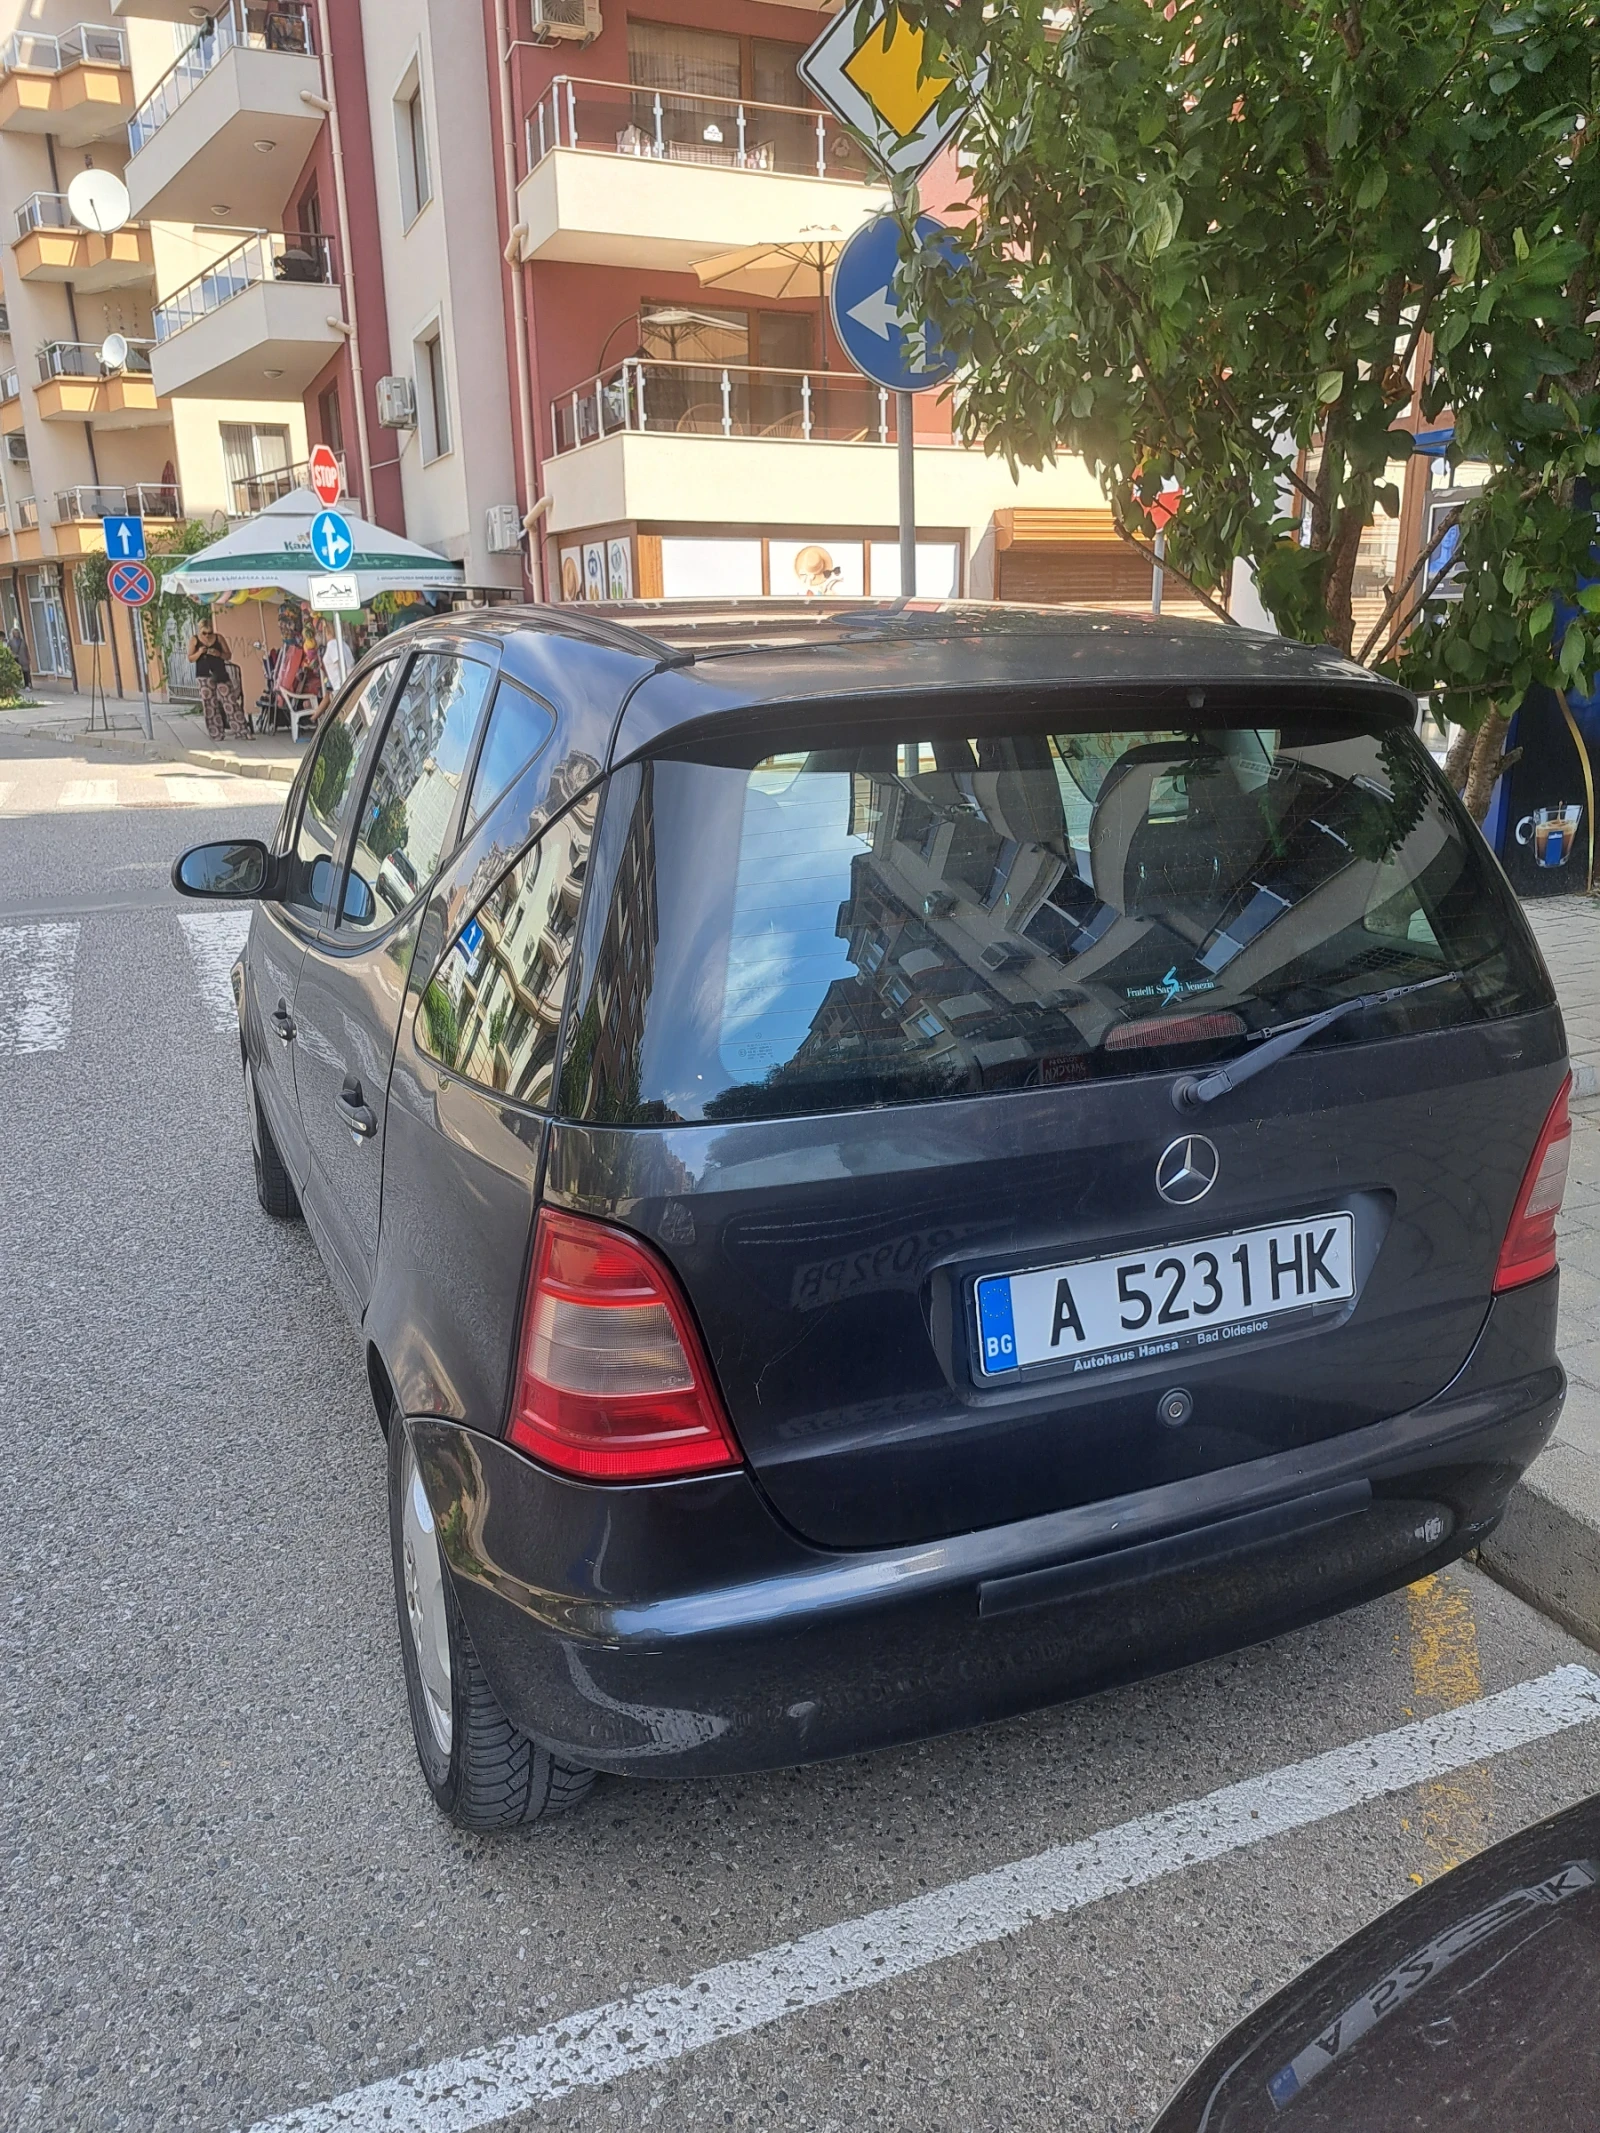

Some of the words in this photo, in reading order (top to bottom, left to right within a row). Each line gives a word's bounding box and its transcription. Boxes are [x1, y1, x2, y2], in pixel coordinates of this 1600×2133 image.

[315, 465, 337, 488] STOP
[1126, 985, 1155, 998] Fratelli
[1156, 983, 1184, 995] Sarri
[1186, 979, 1215, 993] Venezia
[1050, 1278, 1086, 1347] A
[1116, 1244, 1253, 1331] 5231
[1269, 1228, 1341, 1301] HK
[986, 1336, 1013, 1357] BG
[1073, 1349, 1136, 1372] Autohaus
[1138, 1340, 1180, 1358] Hansa
[1197, 1329, 1220, 1346] Bad
[1222, 1319, 1269, 1340] Oldesloe
